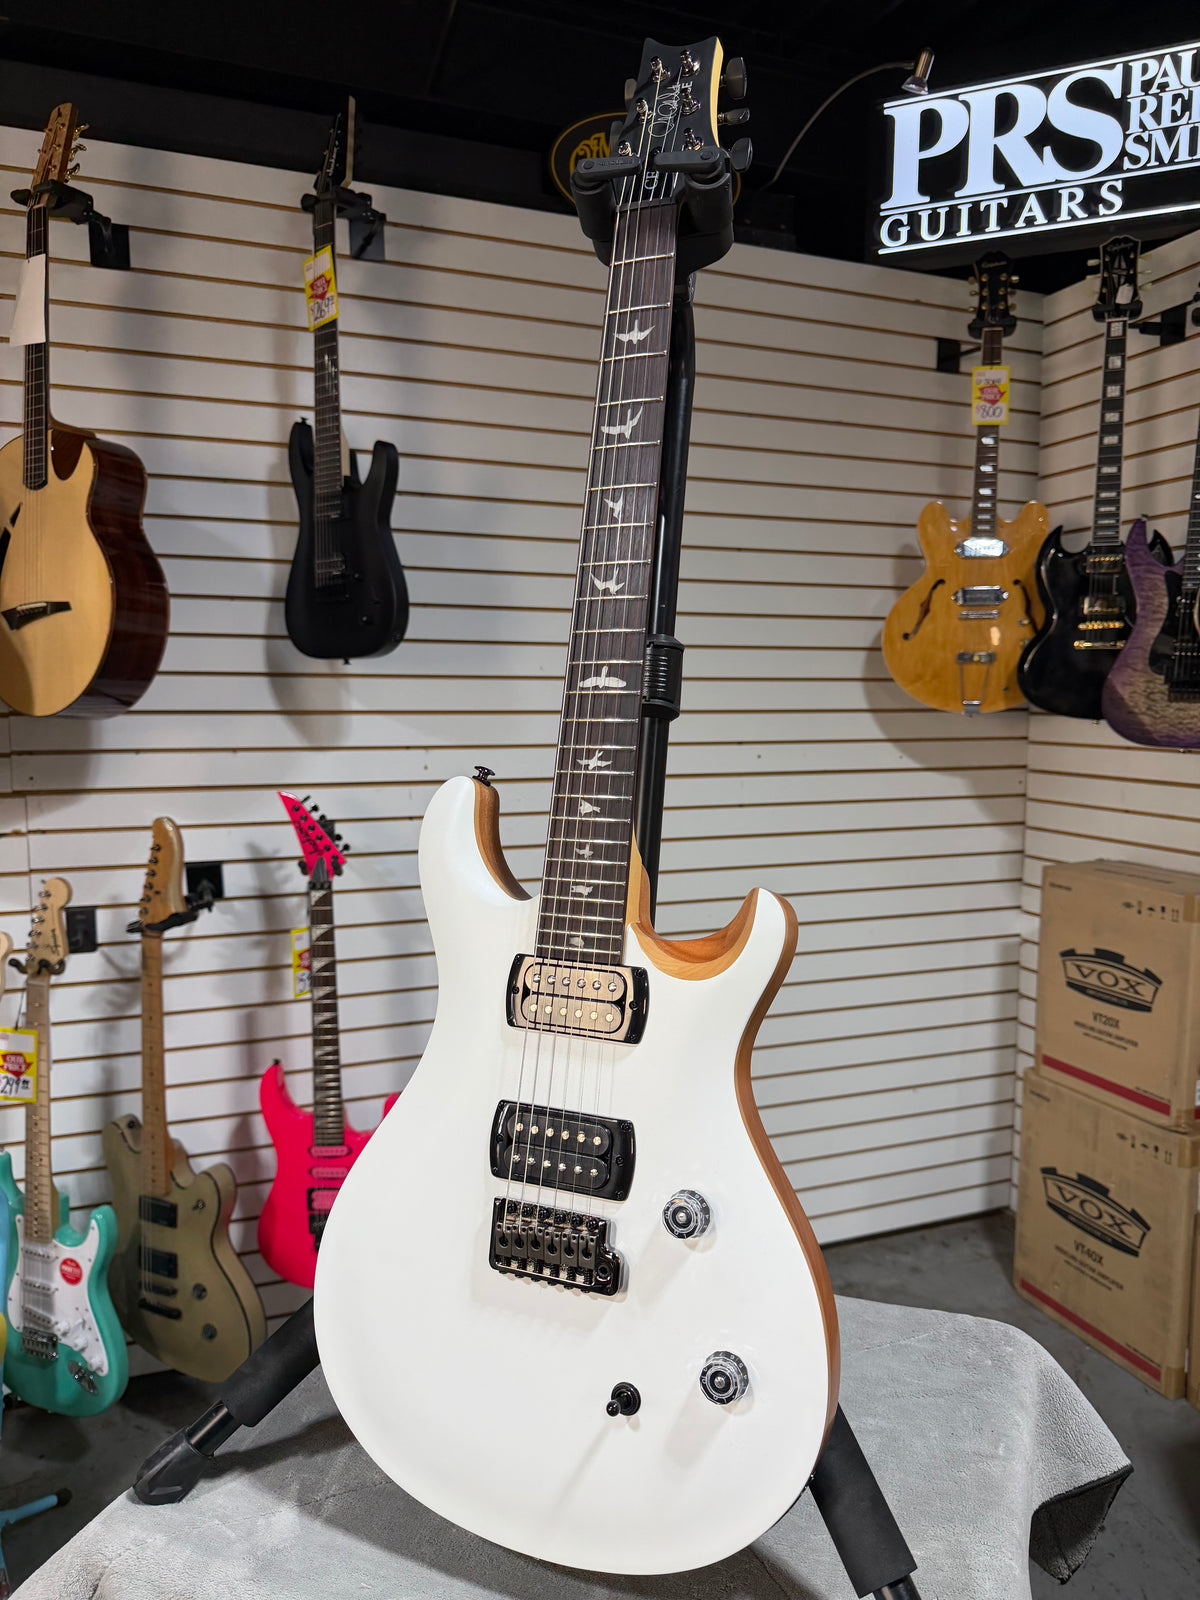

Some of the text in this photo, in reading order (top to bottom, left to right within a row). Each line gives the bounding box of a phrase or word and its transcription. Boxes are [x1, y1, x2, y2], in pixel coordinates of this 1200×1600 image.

[880, 64, 1124, 209] PRS
[880, 179, 1124, 248] GUITARS
[1071, 962, 1147, 998] VOX
[1052, 1182, 1134, 1239] VOX
